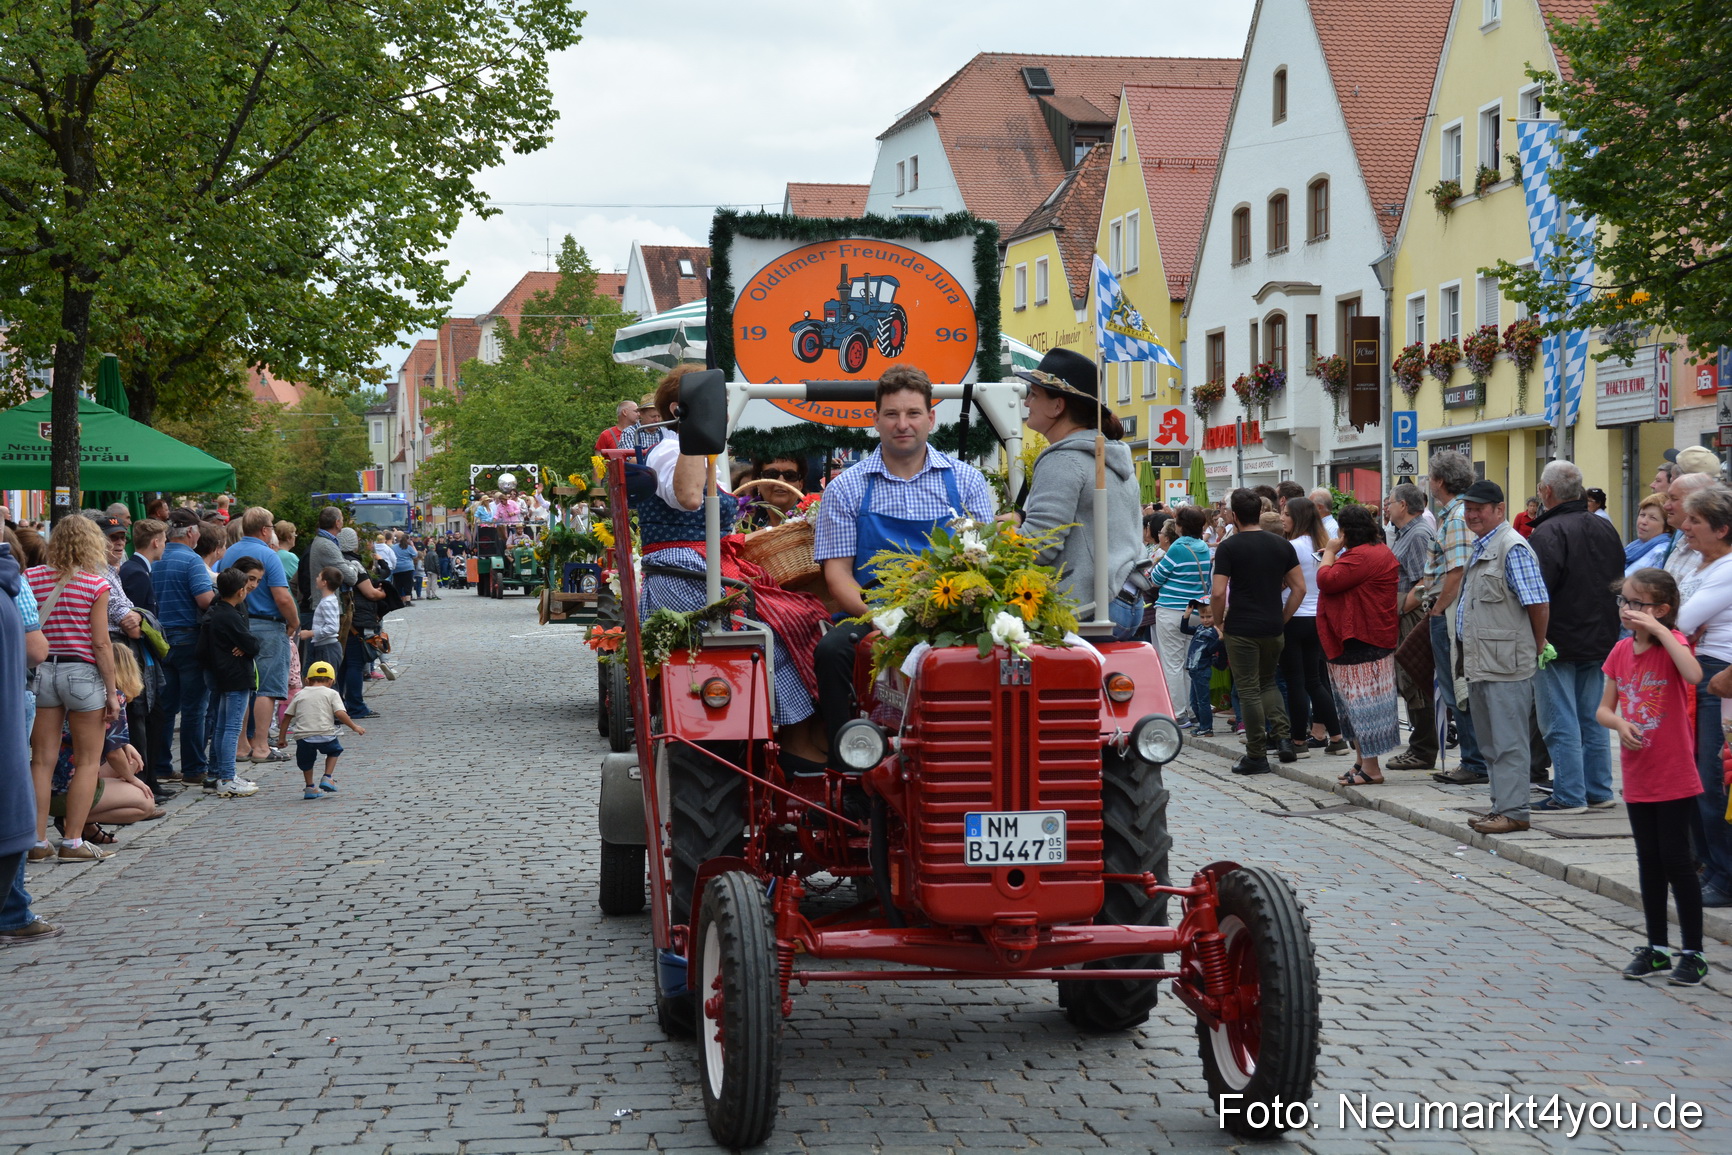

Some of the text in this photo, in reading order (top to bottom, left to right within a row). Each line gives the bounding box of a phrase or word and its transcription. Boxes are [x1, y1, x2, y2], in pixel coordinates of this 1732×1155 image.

[749, 244, 961, 305] Oldtimer-Freunde Jura
[739, 326, 767, 341] 19
[935, 327, 968, 342] 96
[1605, 377, 1645, 396] RIALTO KINO
[1659, 347, 1669, 416] KINO
[1444, 391, 1460, 404] WOLLE
[971, 828, 978, 836] D
[988, 817, 1018, 838] NM
[1048, 837, 1062, 847] 05
[969, 840, 1045, 862] BJ447
[1048, 851, 1062, 860] 09
